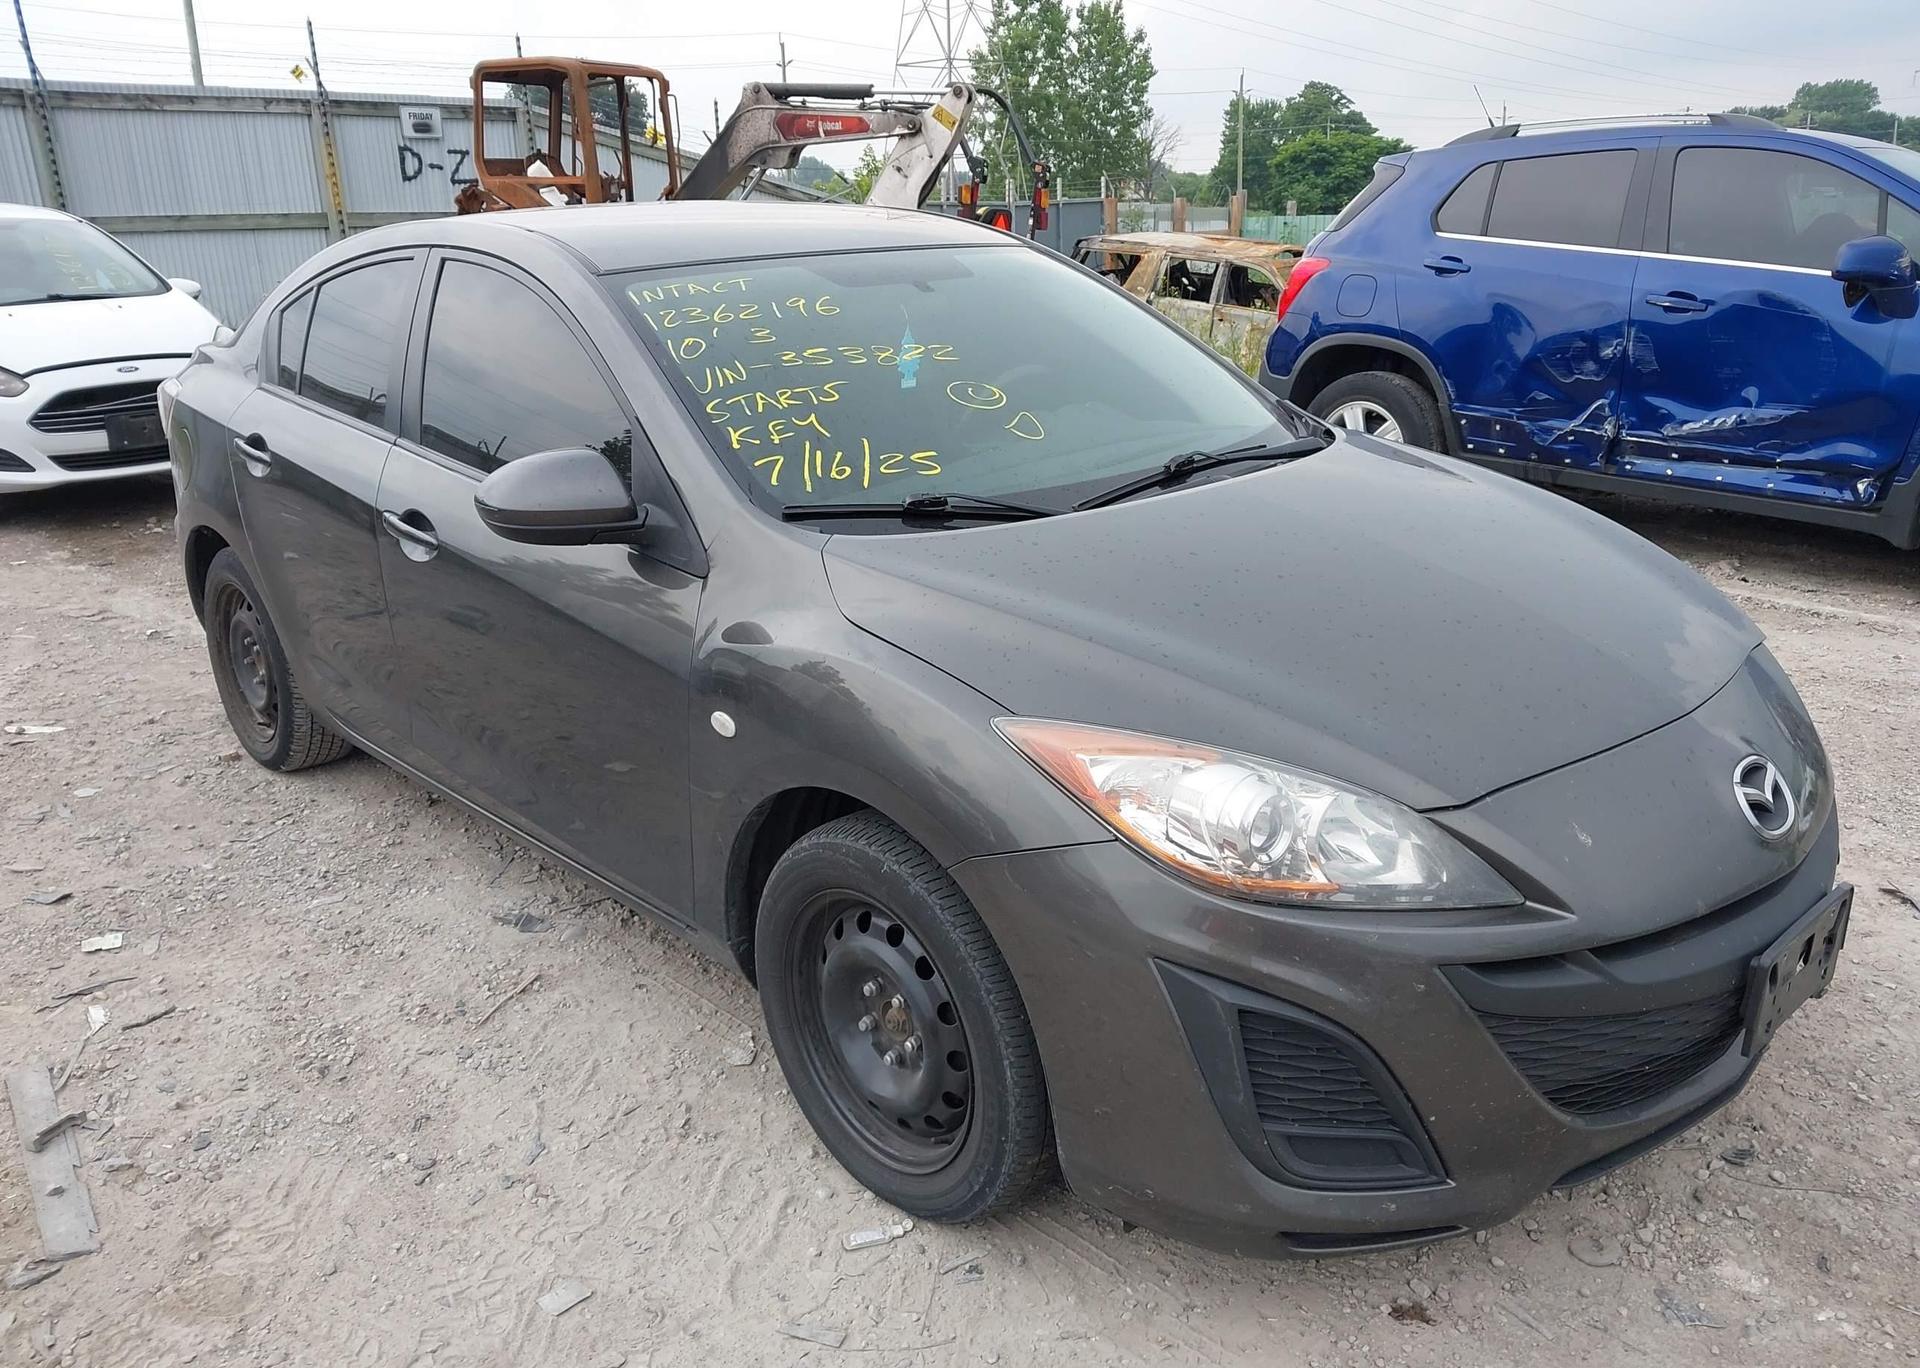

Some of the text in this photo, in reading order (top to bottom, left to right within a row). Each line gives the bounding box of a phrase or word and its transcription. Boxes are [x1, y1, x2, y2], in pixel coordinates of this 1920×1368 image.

[408, 112, 433, 121] FRIDAY
[628, 277, 753, 305] INTACT
[643, 296, 840, 330] 12362196
[706, 381, 849, 423] STARTS
[726, 413, 831, 449] KEY
[754, 437, 942, 493] 7/16/25
